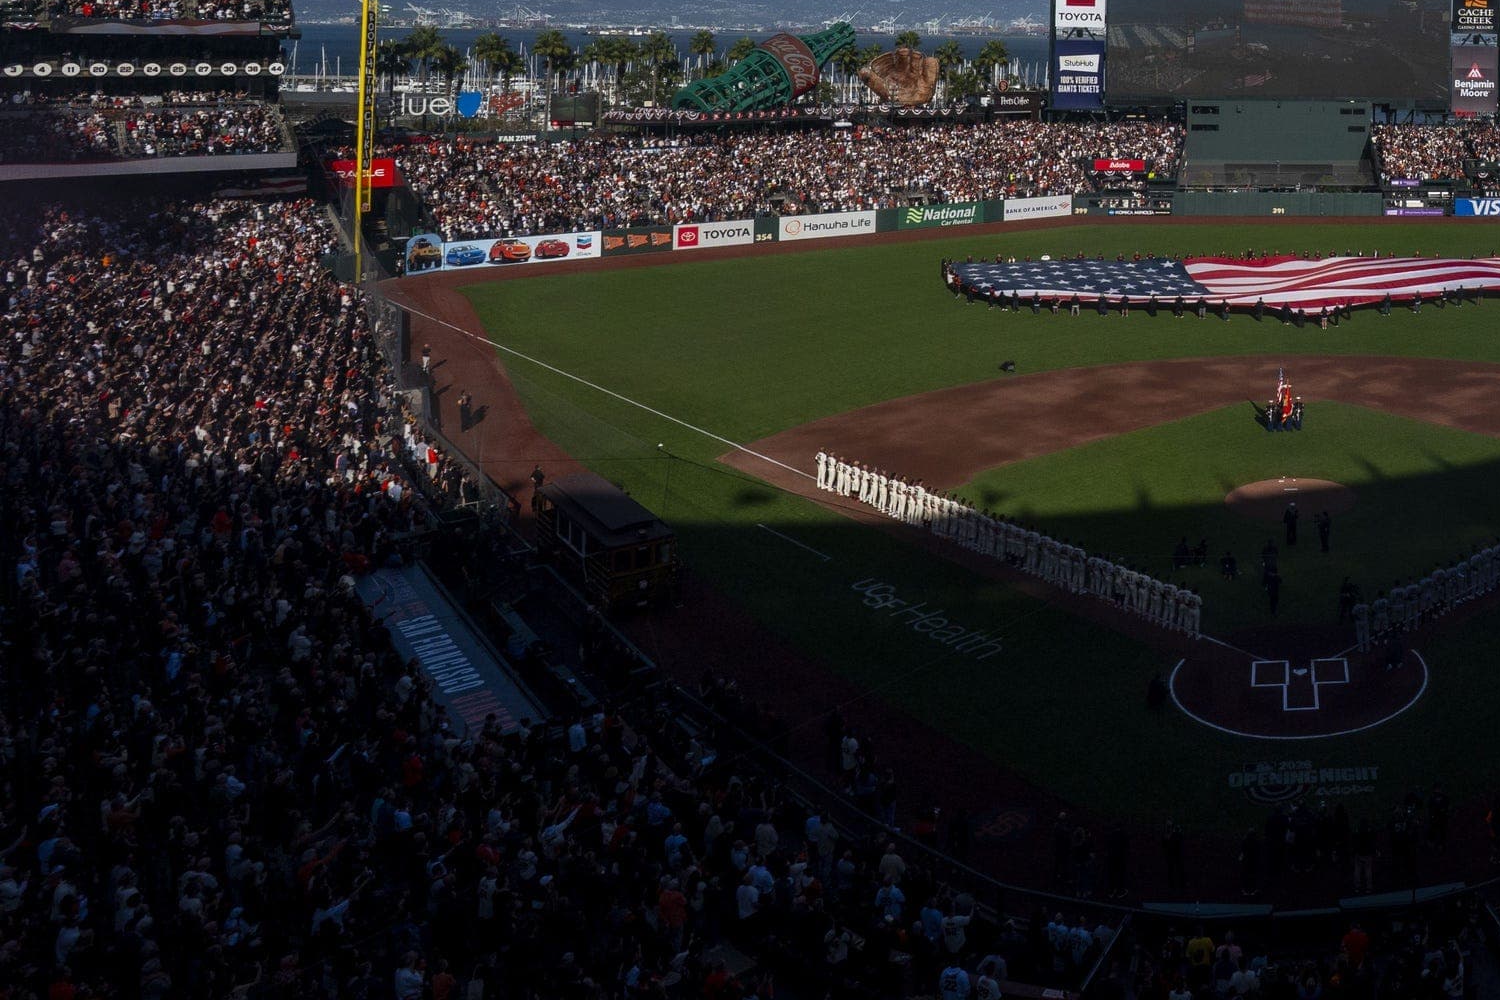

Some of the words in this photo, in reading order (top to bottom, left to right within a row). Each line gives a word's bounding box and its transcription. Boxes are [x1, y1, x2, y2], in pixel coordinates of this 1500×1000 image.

[1059, 12, 1103, 21] TOYOTA
[1458, 9, 1494, 17] CACHE
[1064, 59, 1094, 67] StubHub
[1078, 85, 1099, 93] TICKETS
[1454, 80, 1495, 89] Benjamin
[1460, 89, 1489, 97] Moore
[390, 93, 450, 115] lue
[1110, 161, 1130, 169] Adobe
[923, 205, 976, 221] National
[803, 220, 848, 232] Hanwha
[851, 218, 871, 227] Life
[952, 217, 973, 225] Rental
[703, 228, 750, 239] TOYOTA
[755, 233, 773, 241] 354
[397, 614, 444, 639] SAN
[889, 601, 1004, 660] Health
[410, 633, 485, 694] FRANCISCO
[1228, 769, 1318, 787] OPENING
[1319, 766, 1378, 782] NIGHT
